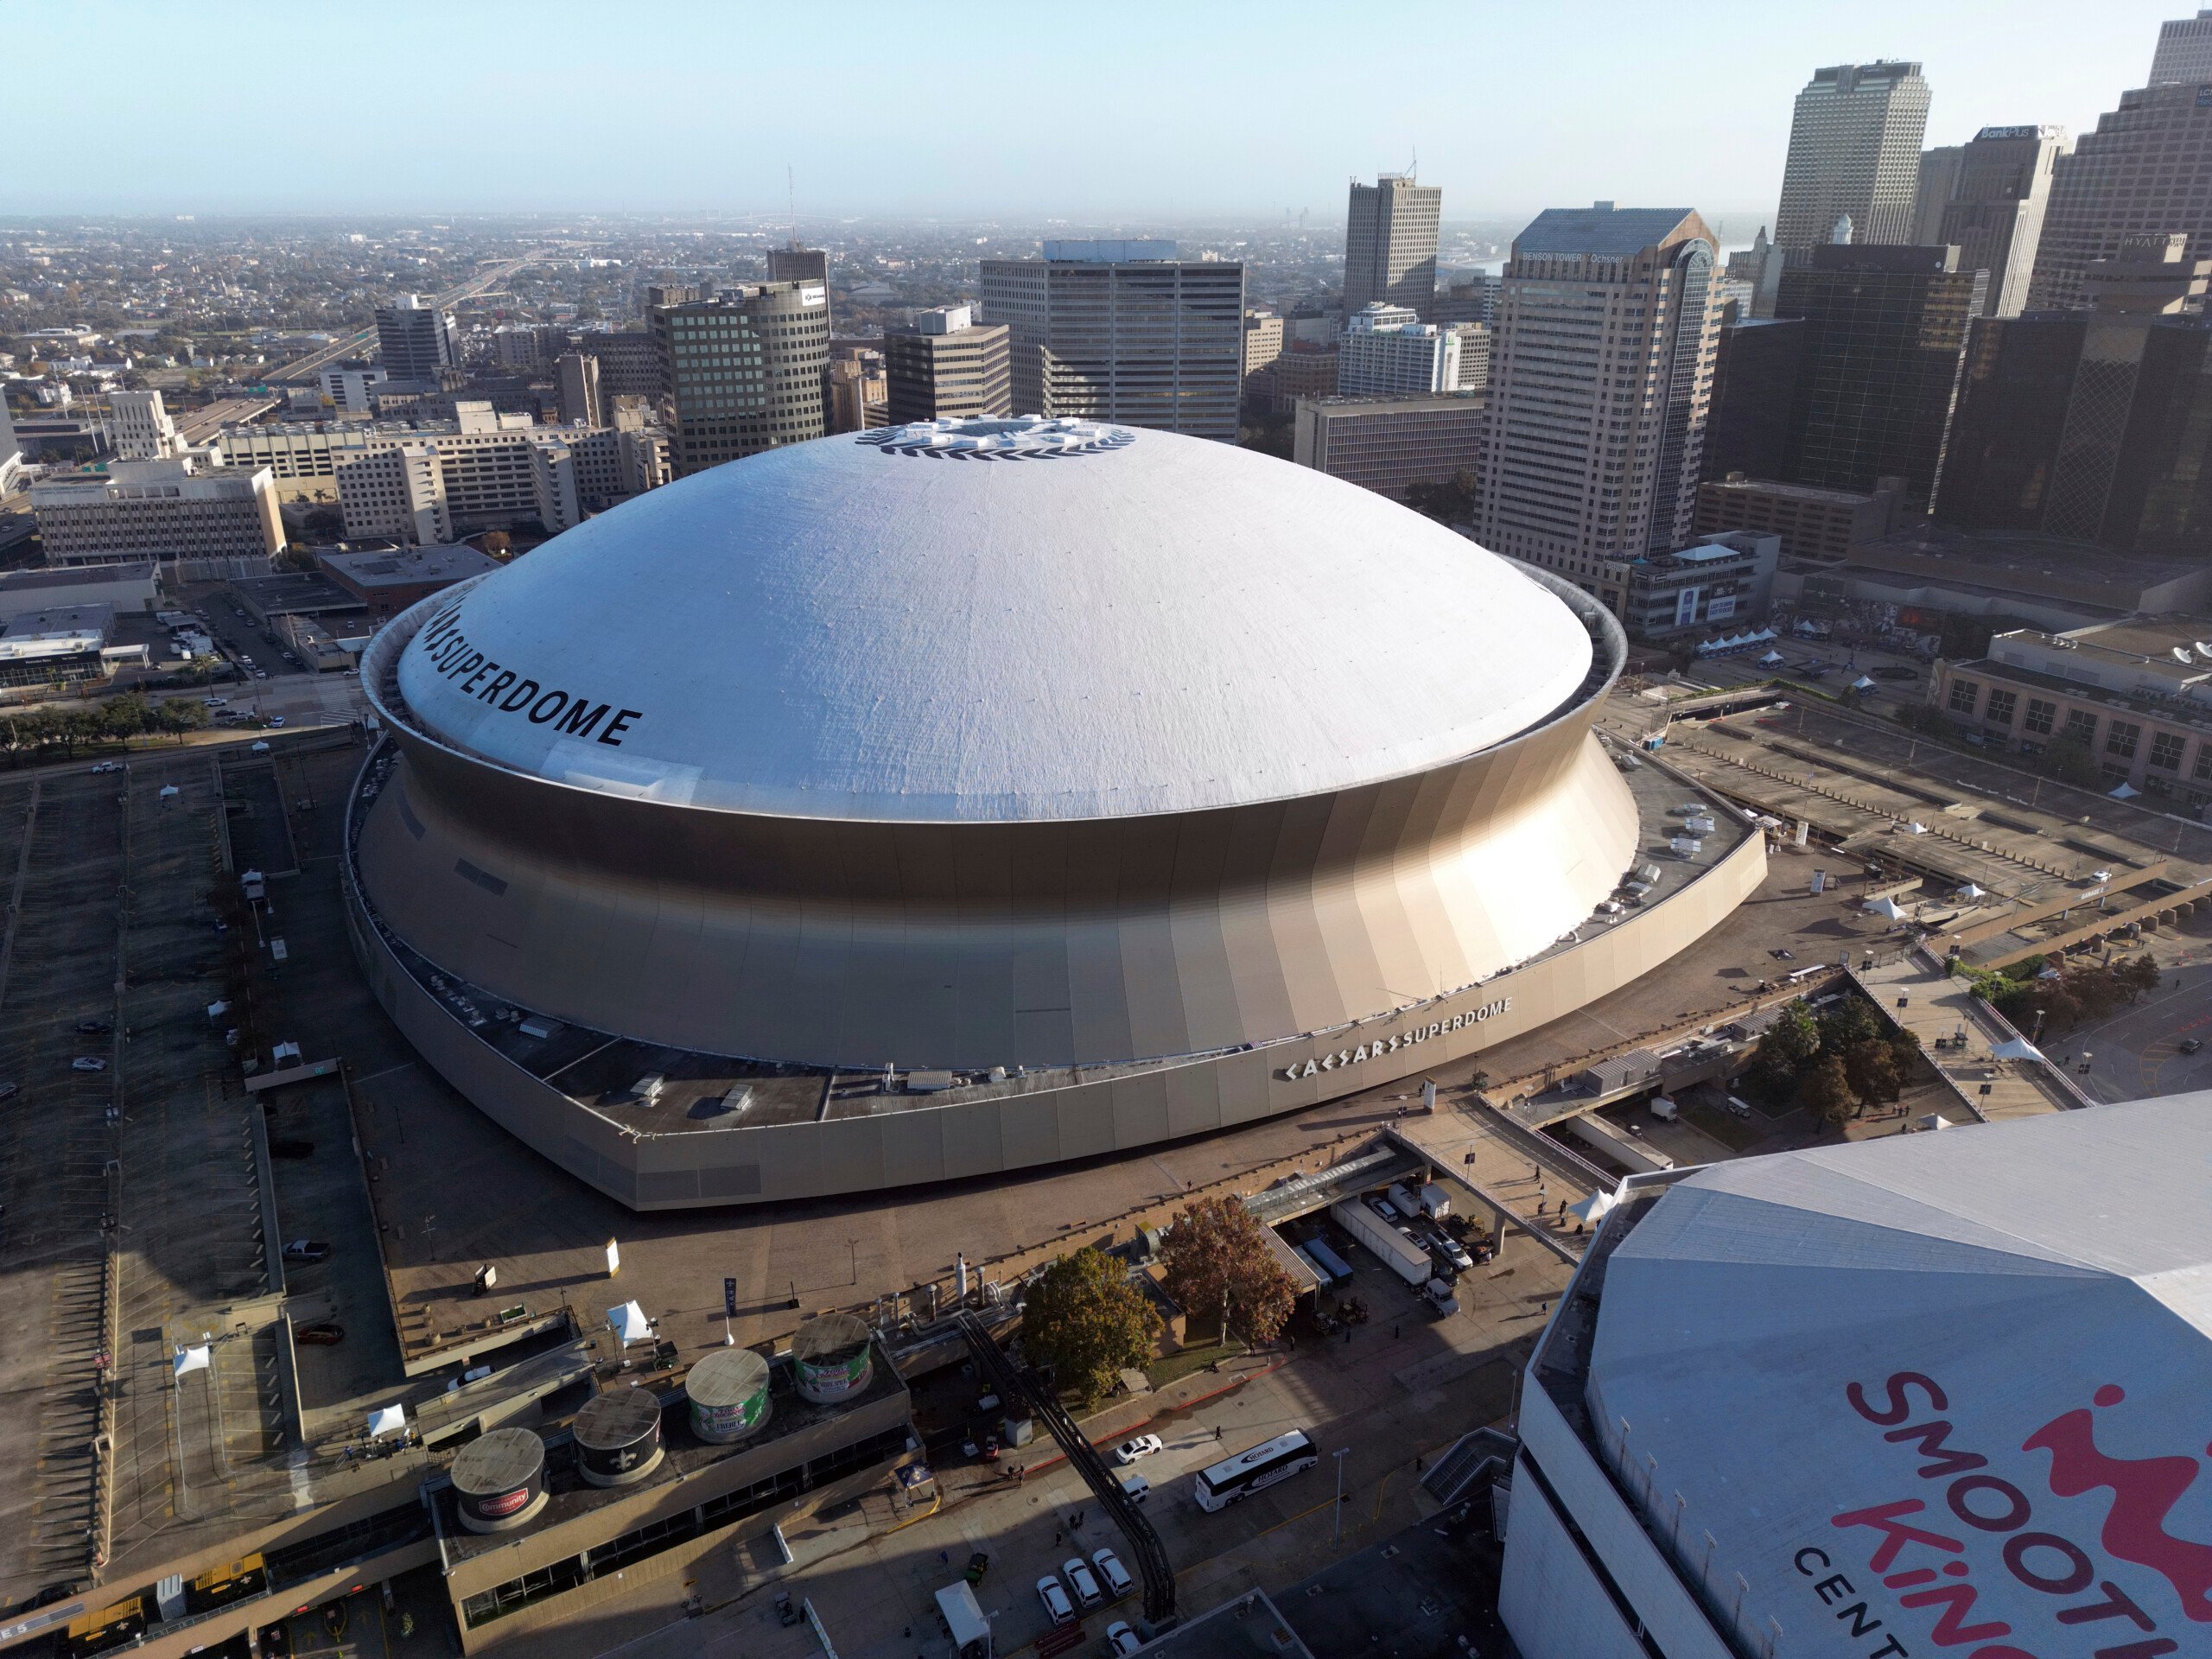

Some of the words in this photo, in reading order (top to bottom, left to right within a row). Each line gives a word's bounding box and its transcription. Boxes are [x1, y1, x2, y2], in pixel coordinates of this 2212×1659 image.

[1981, 127, 2029, 138] BankPlus
[2125, 238, 2168, 247] HYATT
[1522, 252, 1554, 261] BENSON
[1555, 253, 1582, 262] TOWER
[1591, 254, 1624, 264] Ochsner
[430, 635, 644, 747] SUPERDOME
[1285, 1035, 1398, 1080] CAESARS
[1402, 996, 1513, 1048] SUPERDOME
[1249, 1447, 1274, 1460] HOTARD
[1258, 1465, 1287, 1483] HOTARD
[481, 1492, 526, 1511] Community
[1831, 1499, 2040, 1659] KiN
[16, 1623, 28, 1633] 5
